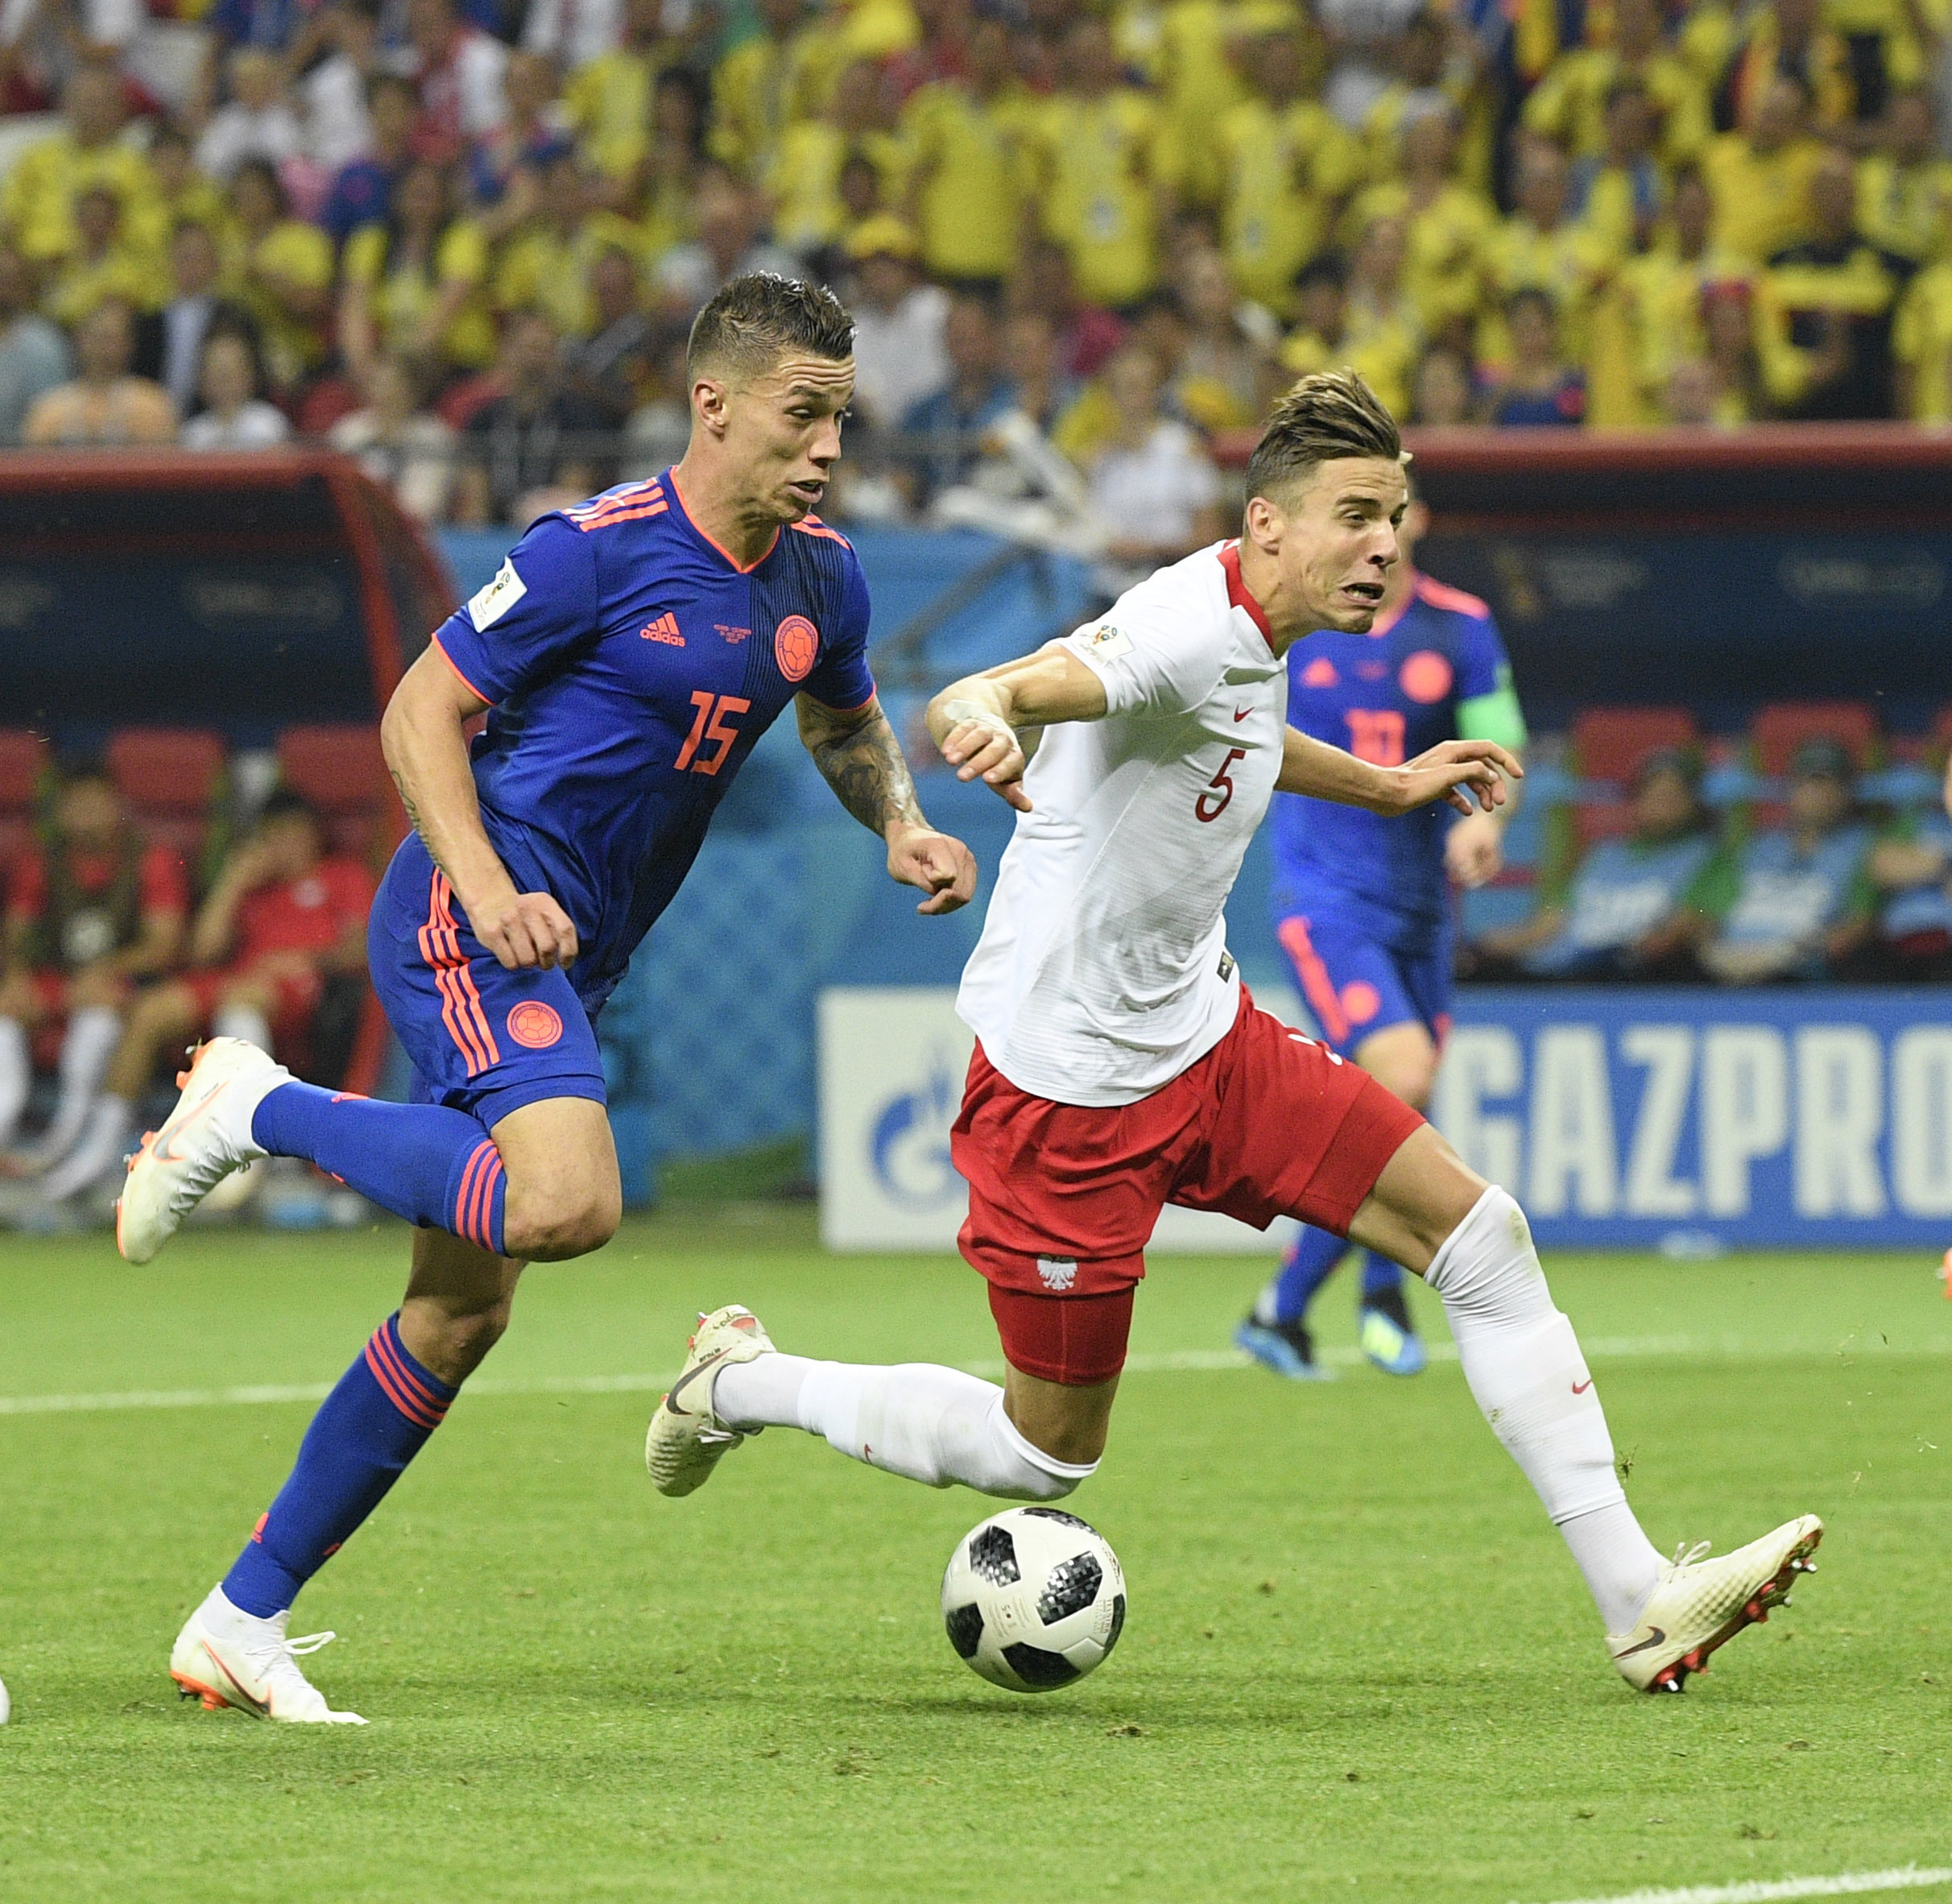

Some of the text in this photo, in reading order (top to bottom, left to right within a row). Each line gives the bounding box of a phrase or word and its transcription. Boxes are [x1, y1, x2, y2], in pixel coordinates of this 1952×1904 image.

[639, 628, 685, 648] adidas
[673, 690, 751, 776] 15
[1195, 747, 1247, 823] 5
